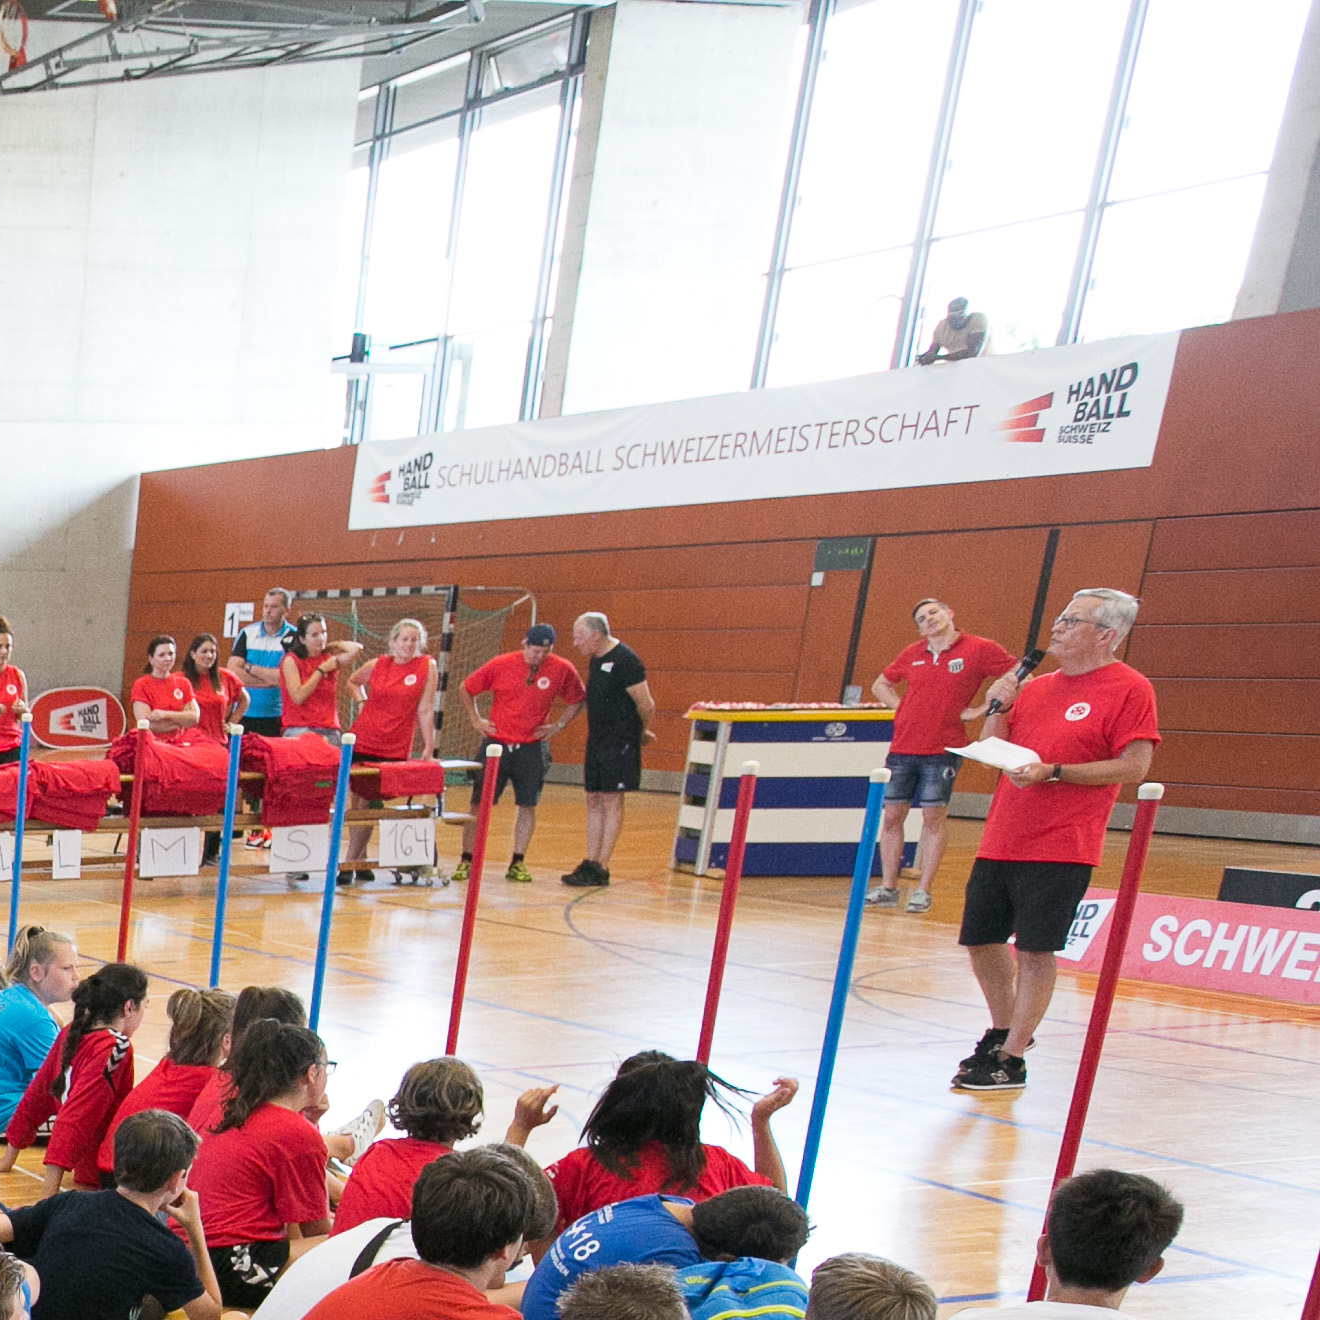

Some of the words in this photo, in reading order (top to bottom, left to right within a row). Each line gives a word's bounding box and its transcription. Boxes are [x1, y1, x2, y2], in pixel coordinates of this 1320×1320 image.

[1067, 362, 1138, 404] HAND
[1073, 392, 1131, 423] BALL
[1057, 434, 1096, 445] SUISSE
[1059, 421, 1111, 435] SCHWEIZ
[437, 448, 604, 489] SCHULHANDBALL
[612, 404, 981, 471] SCHWEIZERMEISTERSCHAFT
[398, 452, 434, 477] HAND
[403, 473, 431, 492] BALL
[228, 612, 235, 637] 1
[57, 833, 76, 869] L
[151, 836, 187, 866] M
[273, 829, 311, 863] S
[388, 822, 429, 858] 164
